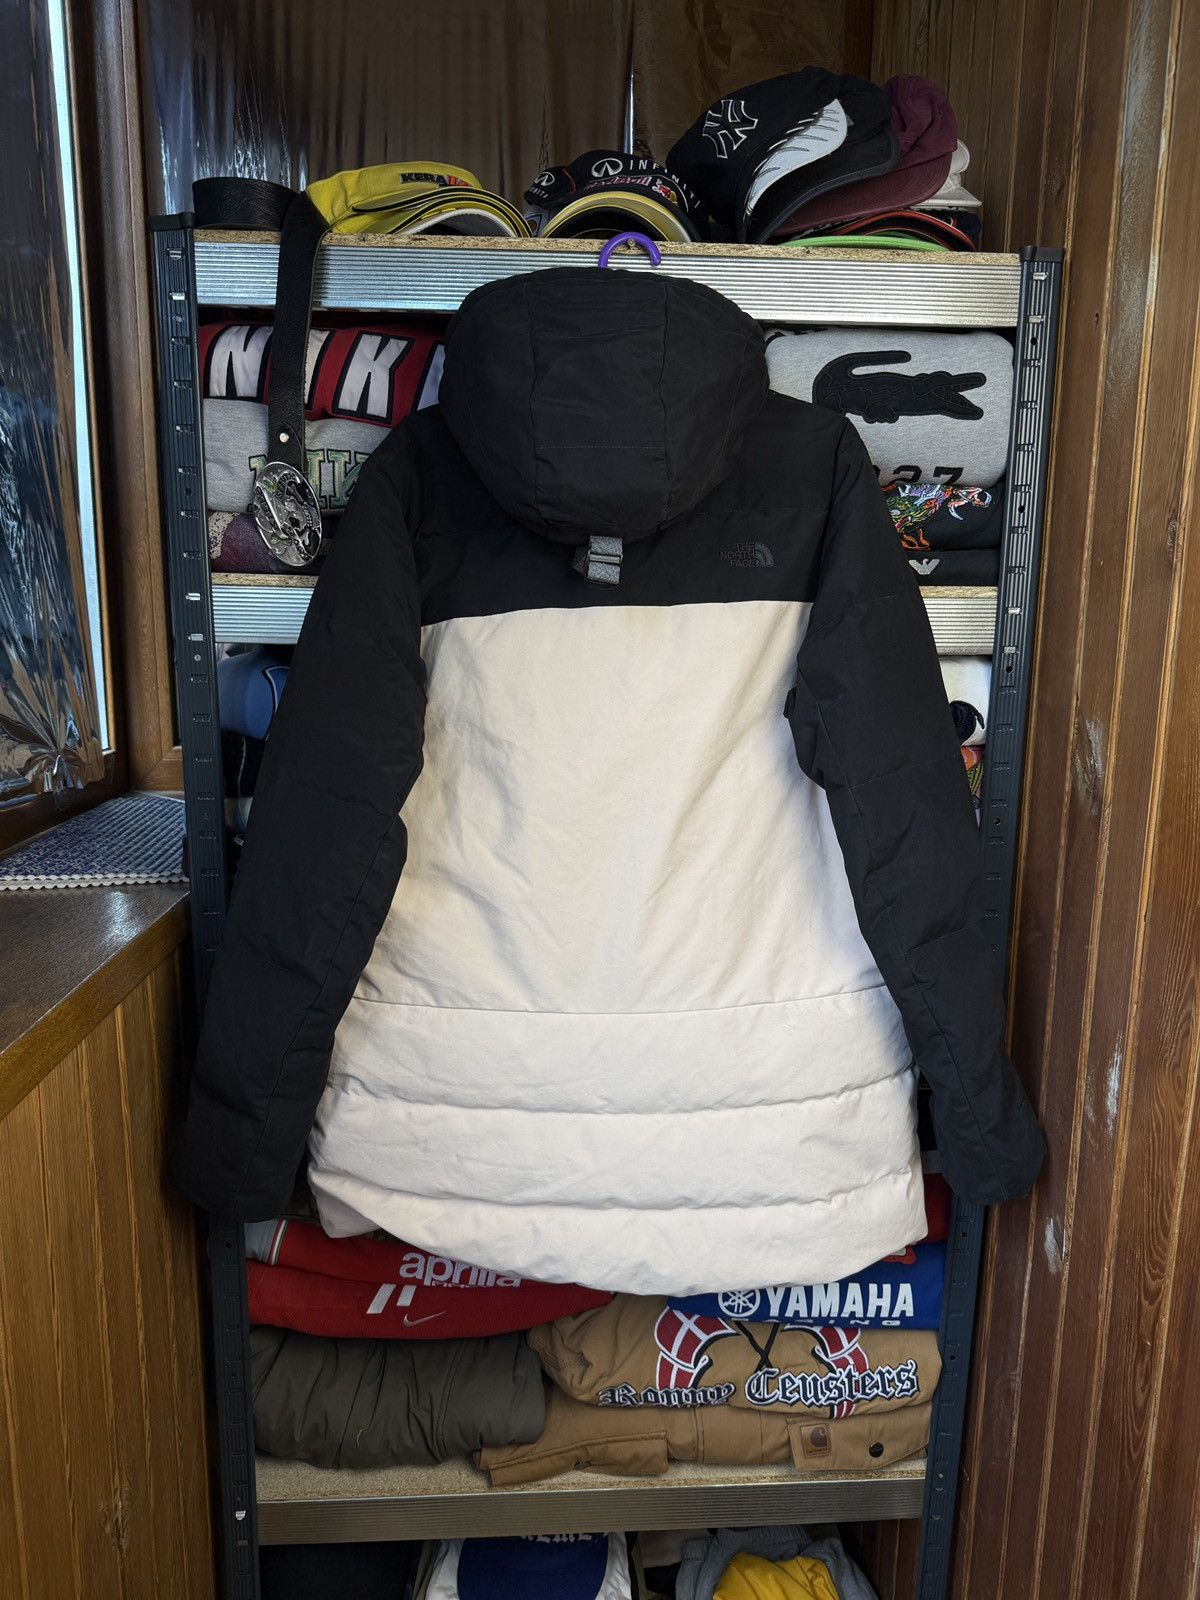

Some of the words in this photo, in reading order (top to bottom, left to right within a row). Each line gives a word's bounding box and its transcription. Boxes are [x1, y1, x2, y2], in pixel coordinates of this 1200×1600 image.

[204, 325, 445, 423] NIK
[719, 551, 756, 560] NORTH
[730, 559, 756, 568] FACE
[766, 1282, 914, 1318] YAMAHA
[598, 1382, 736, 1408] Ronny
[744, 1360, 922, 1407] Ceusters
